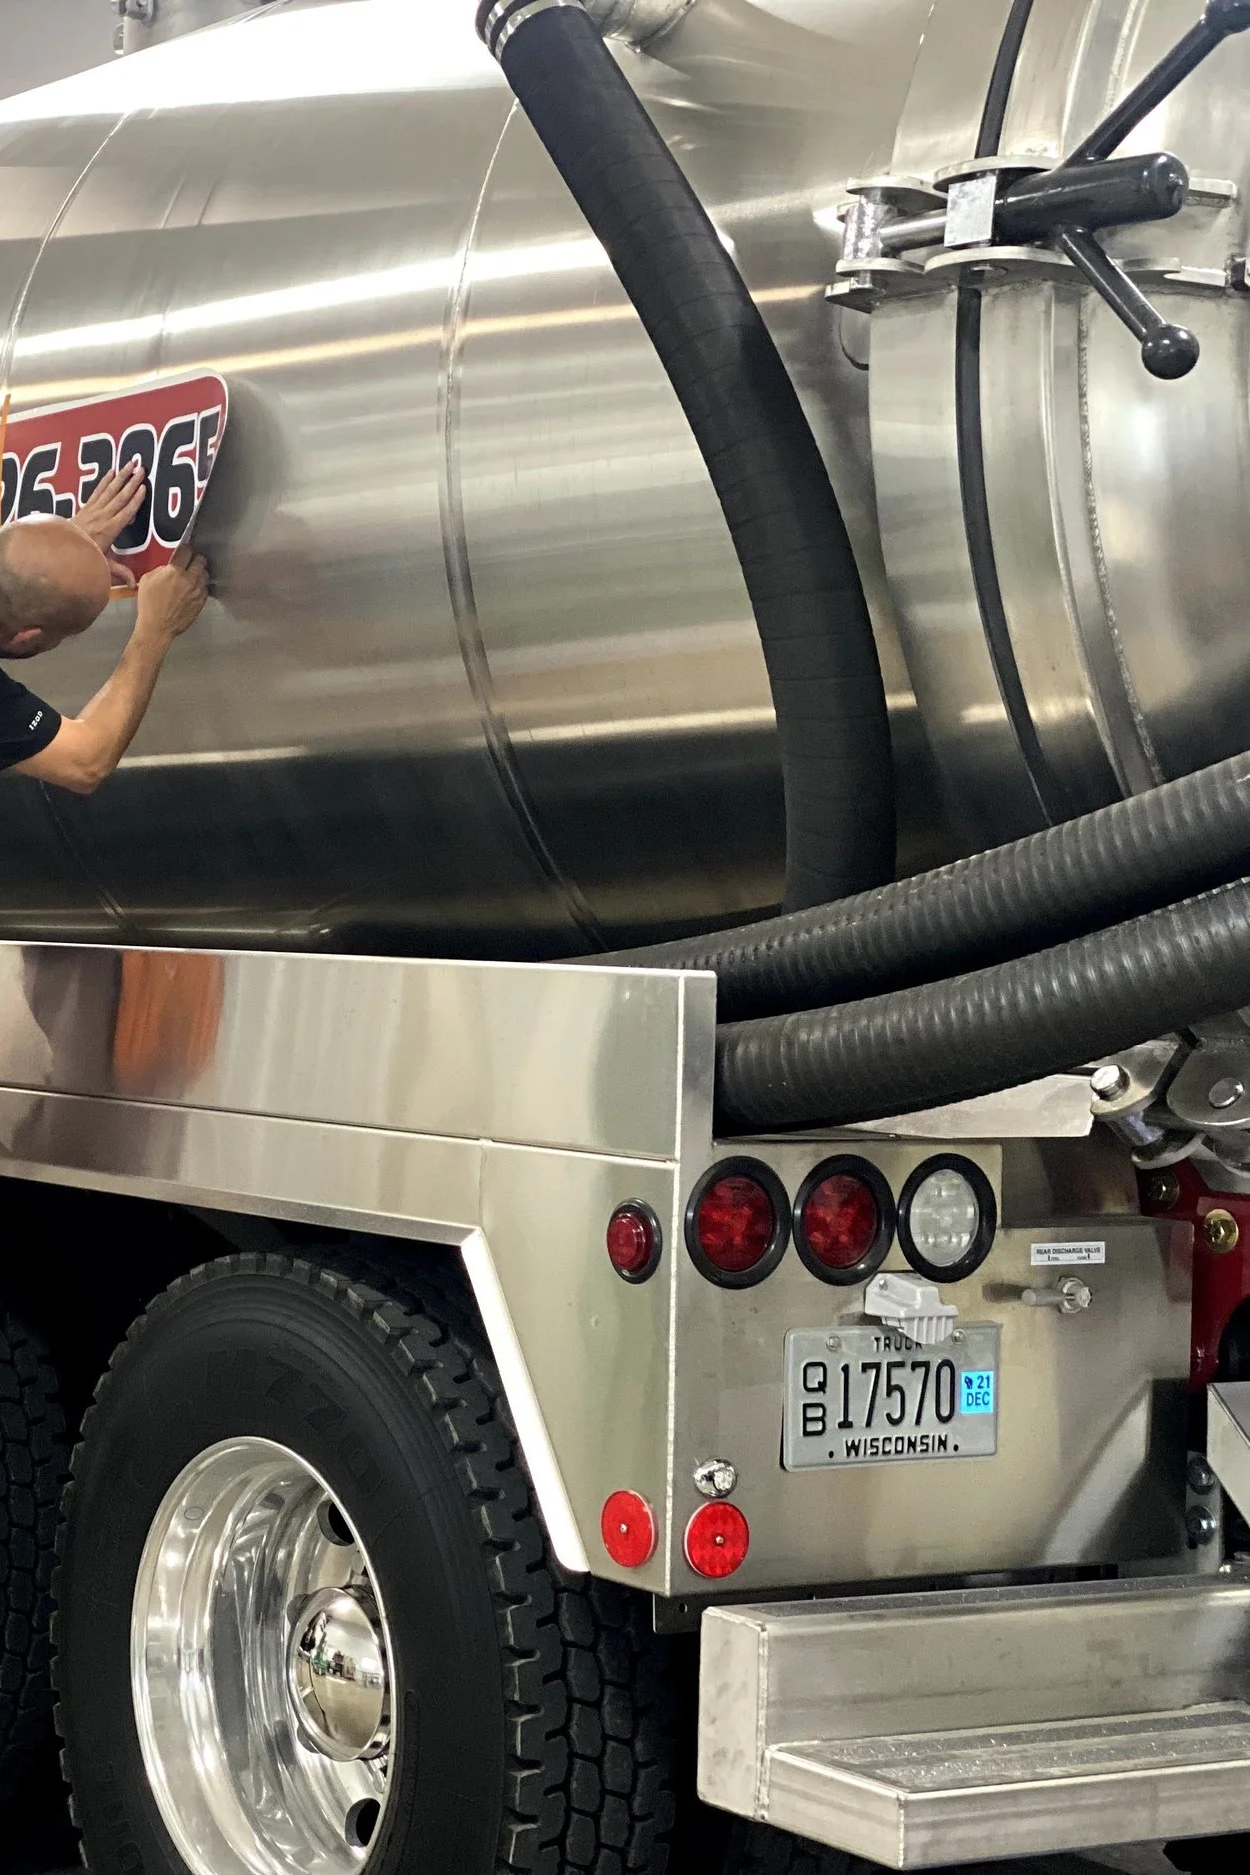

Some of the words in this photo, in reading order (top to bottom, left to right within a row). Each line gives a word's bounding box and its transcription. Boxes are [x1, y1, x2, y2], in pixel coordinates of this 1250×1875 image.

[977, 1375, 990, 1389] 21
[838, 1359, 956, 1429] 17570
[966, 1391, 990, 1407] DEC
[844, 1434, 948, 1458] WISCONSIN
